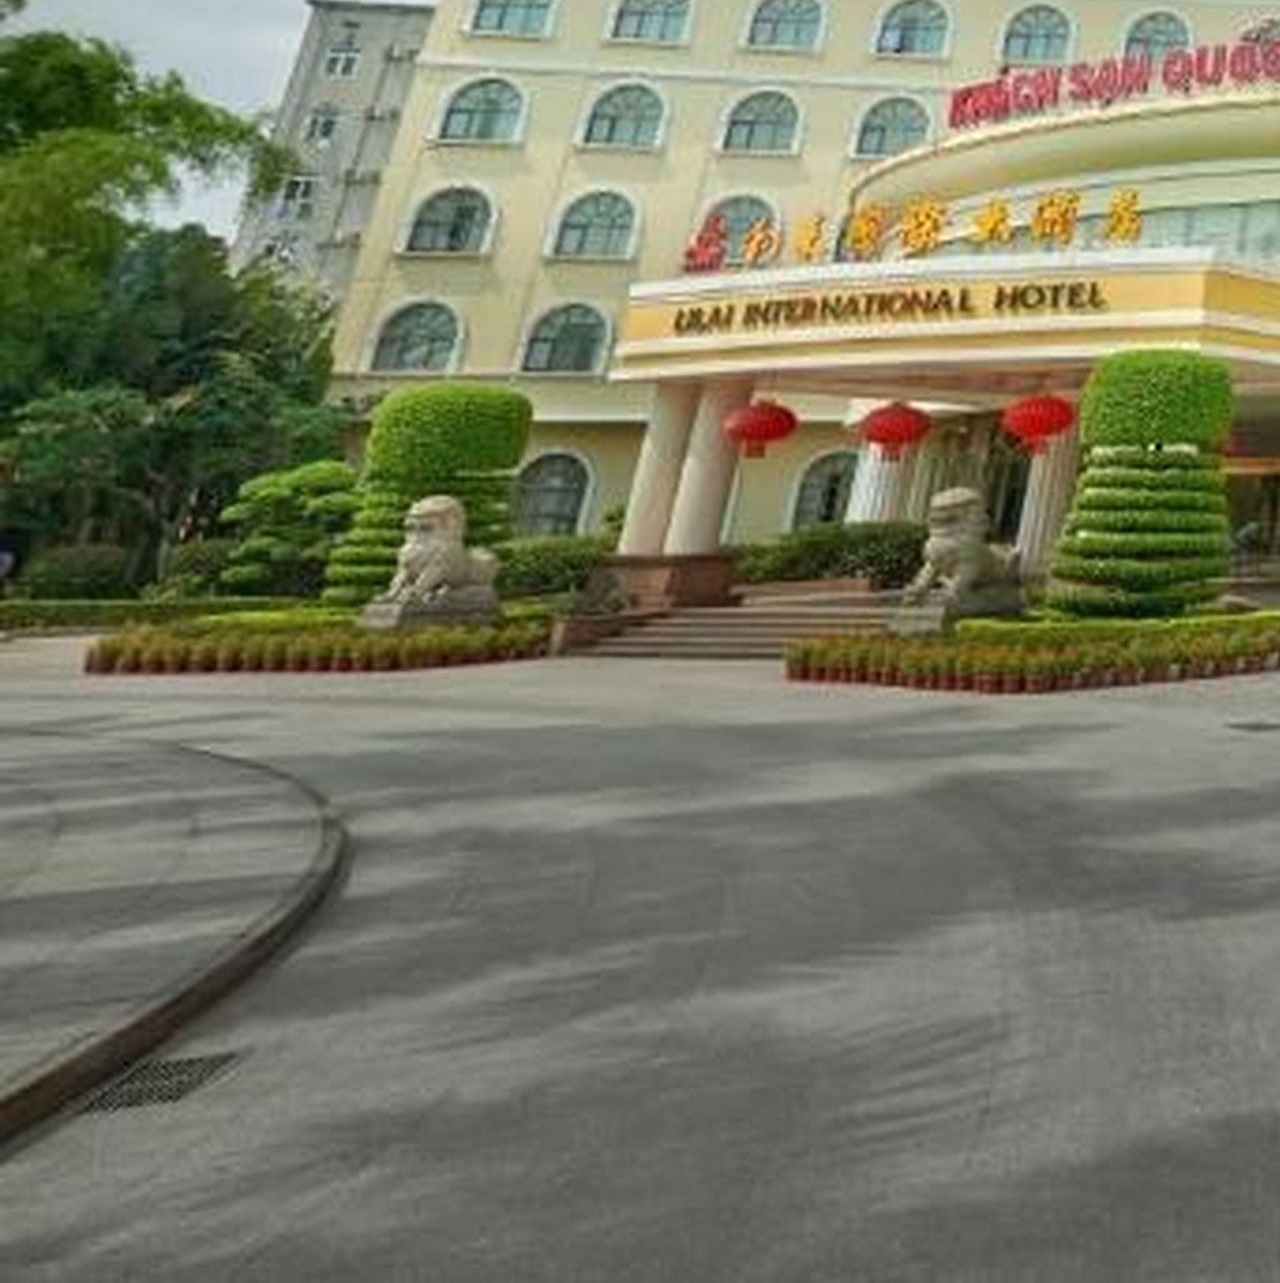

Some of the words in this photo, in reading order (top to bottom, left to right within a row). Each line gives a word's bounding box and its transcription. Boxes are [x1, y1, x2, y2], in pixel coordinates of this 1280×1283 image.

[1069, 55, 1149, 105] SẠN
[741, 289, 974, 330] INTERNATIONAL
[994, 281, 1106, 310] HOTEL
